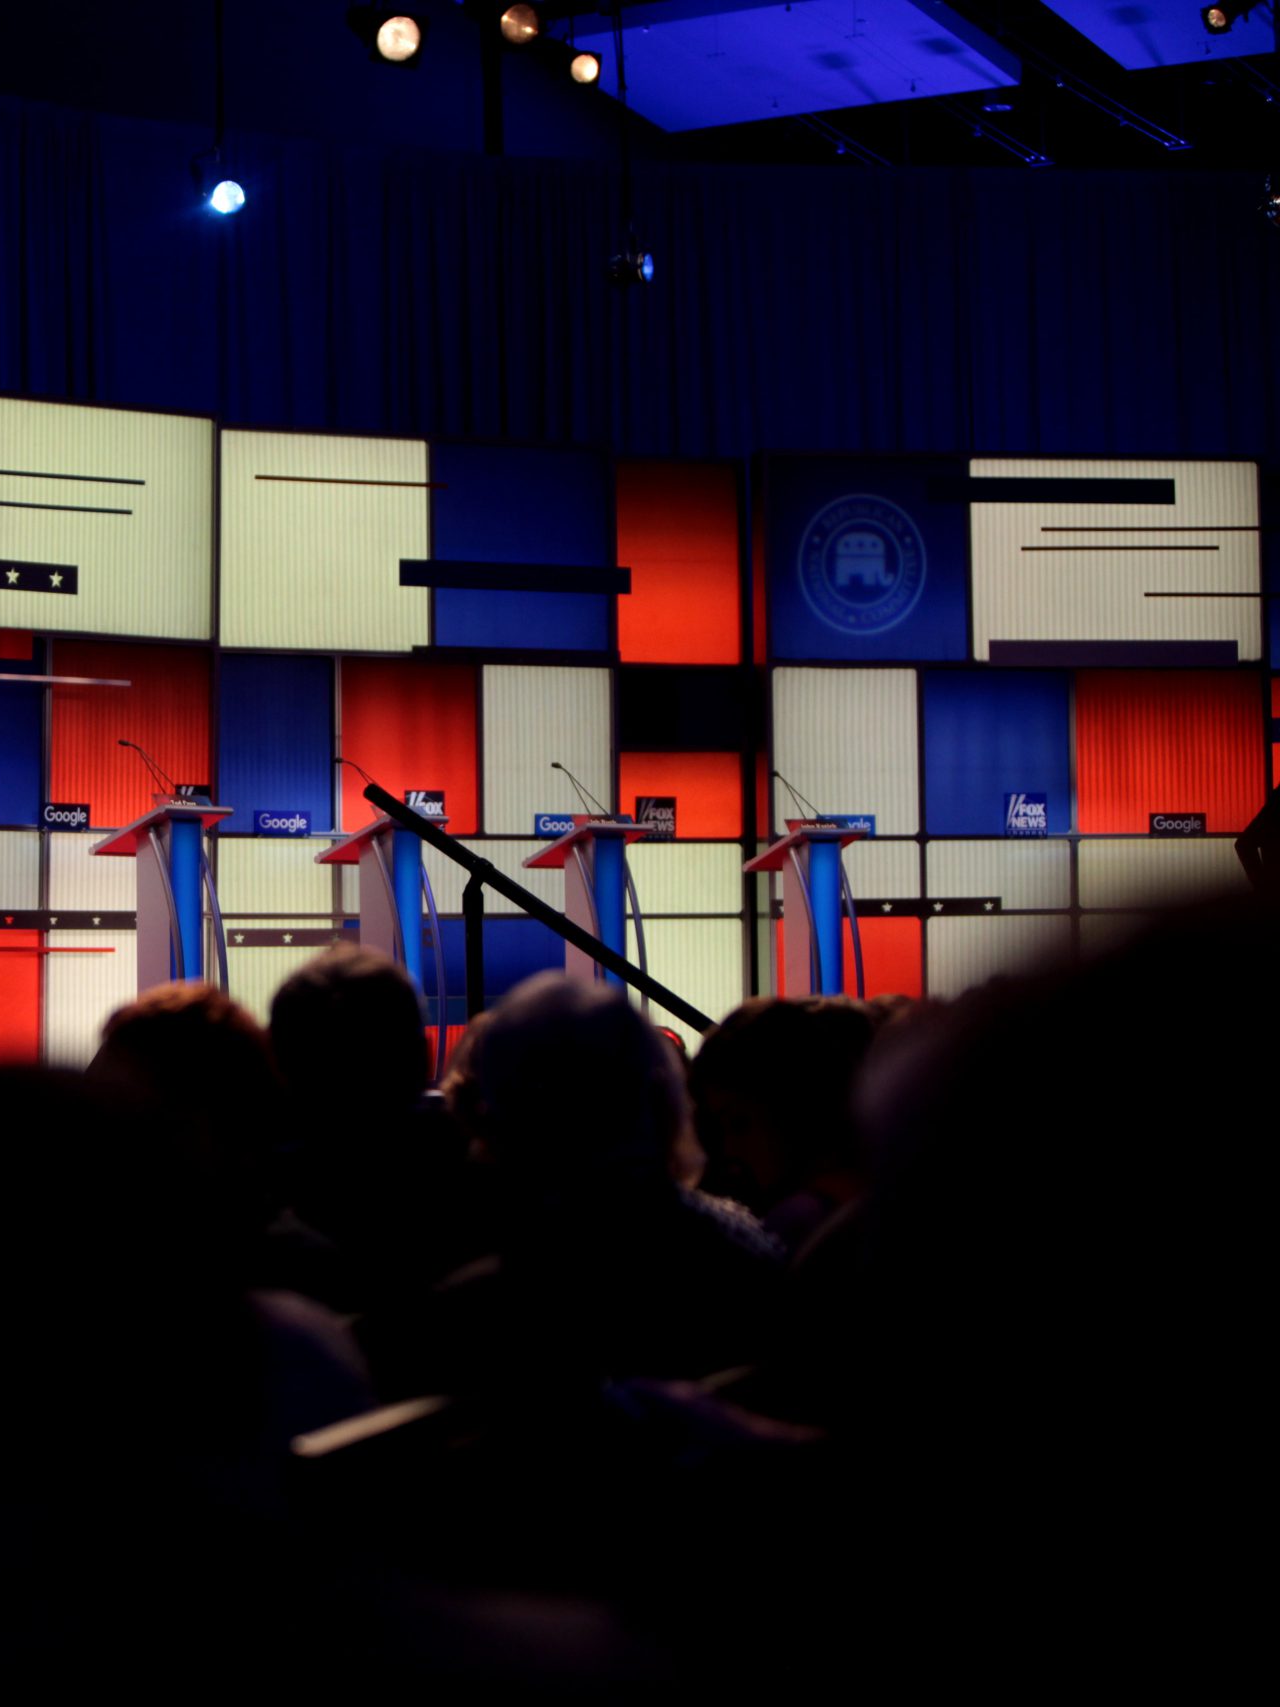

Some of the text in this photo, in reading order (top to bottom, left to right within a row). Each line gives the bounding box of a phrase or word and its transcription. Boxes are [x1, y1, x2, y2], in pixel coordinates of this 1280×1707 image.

[43, 805, 87, 826] Google
[649, 807, 674, 820] FOX
[1019, 803, 1045, 816] FOX
[259, 813, 307, 833] Google
[1011, 816, 1047, 828] NEWS
[1153, 815, 1202, 833] Google
